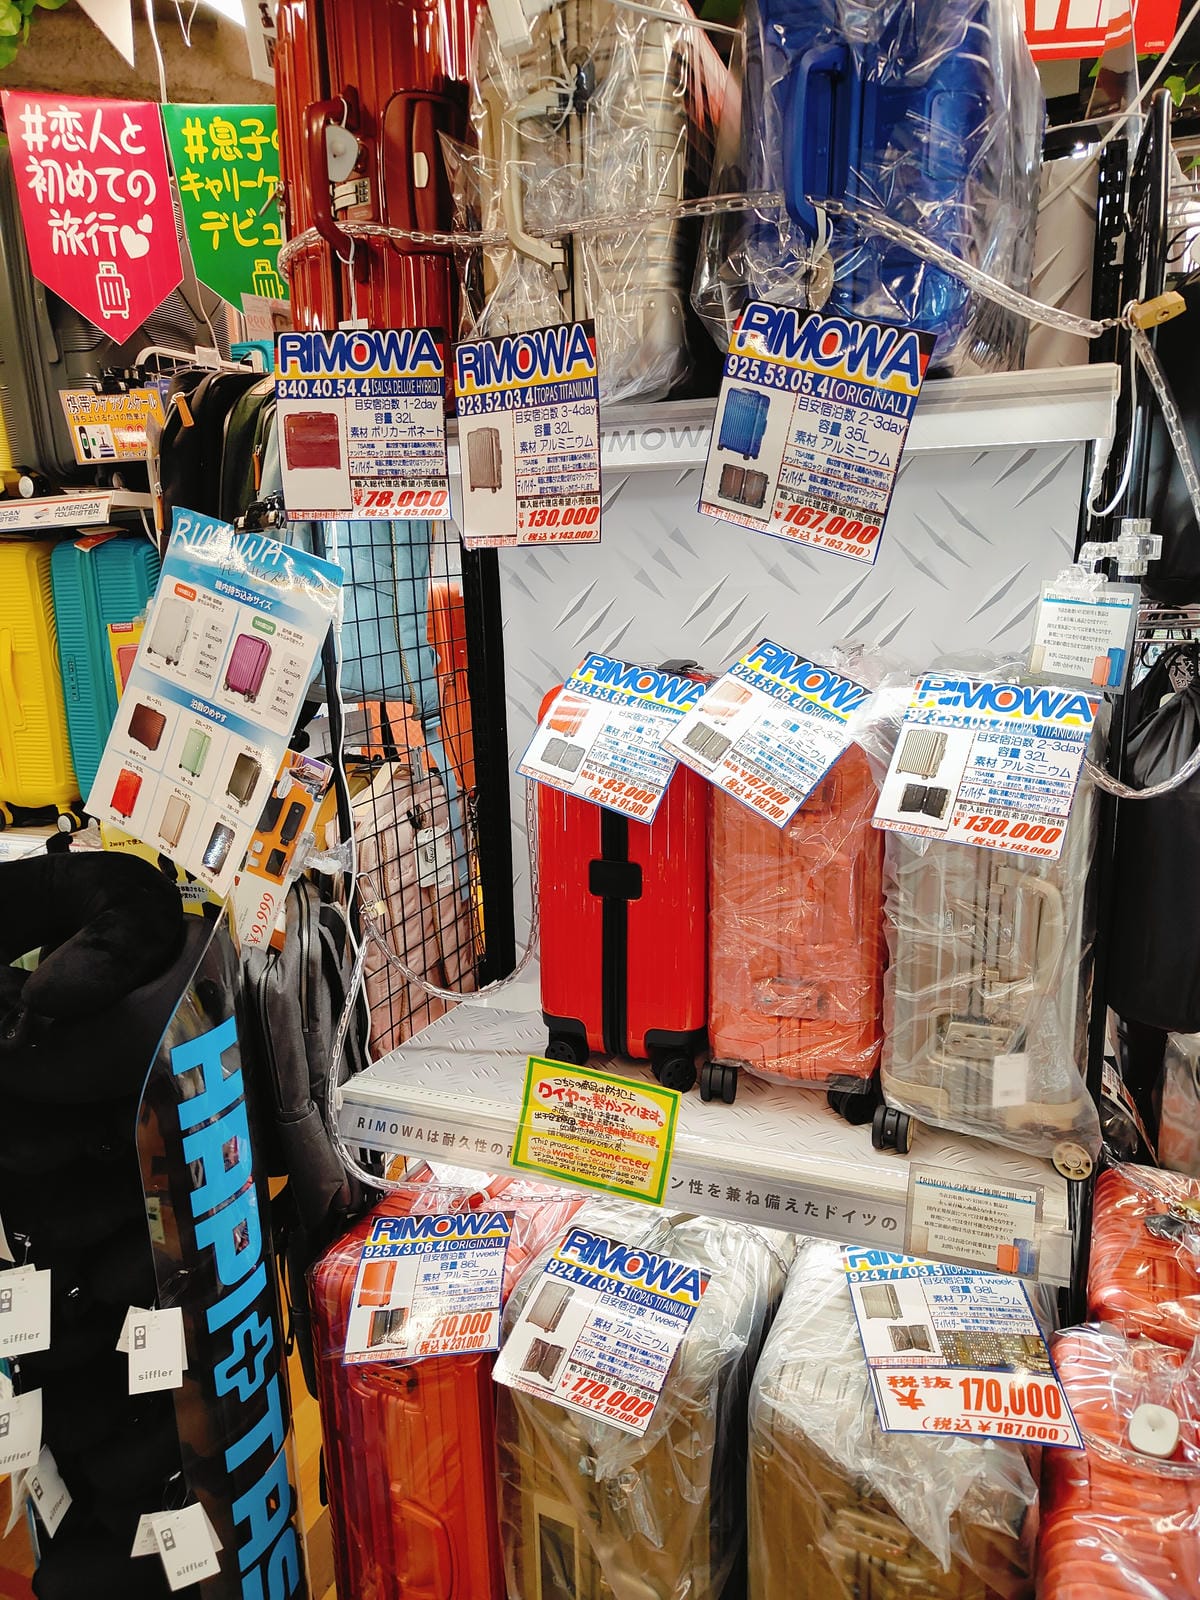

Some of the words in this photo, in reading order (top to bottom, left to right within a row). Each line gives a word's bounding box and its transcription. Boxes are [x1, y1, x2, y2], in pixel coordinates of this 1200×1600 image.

[19, 104, 146, 155] #恋人と
[26, 156, 157, 205] 初めての
[279, 331, 443, 374] RIMOWA
[458, 325, 594, 389] RIMOWA
[738, 304, 921, 388] RIMOWA
[355, 399, 400, 411] 目安宿泊数
[403, 399, 437, 412] 1-2day
[515, 407, 559, 424] 目安宿泊数
[561, 404, 596, 420] 3-4day
[797, 396, 855, 423] 目安宿泊数
[858, 411, 907, 437] 2-3day
[374, 413, 393, 424] 容量
[396, 412, 415, 424] 32L
[534, 424, 552, 437] 容量
[554, 422, 574, 435] 32L
[351, 427, 368, 439] 素材
[600, 425, 711, 453] IMOW
[818, 419, 842, 437] 容量
[844, 425, 870, 445] 35L
[520, 441, 537, 453] 素材
[540, 435, 594, 452] アルミニウム
[795, 430, 818, 448] 素材
[821, 435, 890, 467] アルミニウム
[56, 502, 101, 512] AMERICAN
[172, 516, 283, 566] RIMWA
[579, 654, 706, 706] RIMOWA
[920, 678, 1093, 723] RIMOWA
[778, 734, 827, 766] ルミニウム
[976, 732, 1035, 748] 目安宿泊数
[1036, 739, 1083, 755] 2-3day
[997, 746, 1021, 759] 容量
[1023, 750, 1049, 763] 32L
[974, 755, 997, 768] 素材
[1001, 758, 1071, 779] アルミニウム
[248, 892, 275, 945] ¥9,999
[531, 1136, 548, 1146] This
[549, 1140, 580, 1153] product
[589, 1148, 651, 1171] connected
[556, 1155, 576, 1165] would
[670, 1175, 898, 1232] ン性を兼ね備えたドイツの
[372, 1212, 510, 1243] RIMOWA
[422, 1272, 441, 1283] 素材
[443, 1268, 497, 1280] アルミニウム
[440, 1260, 458, 1271] 容量
[460, 1259, 480, 1270] 86L
[561, 1230, 700, 1302] RIMOWA
[923, 1276, 975, 1286] 目安宿泊数
[950, 1285, 971, 1295] 容量
[974, 1285, 997, 1295] 98L
[599, 1294, 648, 1317] 目安宿泊数
[932, 1294, 955, 1304] 素材
[958, 1294, 1022, 1306] アルミニウム
[2, 1330, 41, 1346] siffler
[591, 1317, 613, 1332] 素材
[614, 1324, 670, 1354] アルミニウム
[138, 1368, 174, 1382] siffler
[886, 1375, 954, 1390] 税抜
[175, 1556, 209, 1578] siffler
